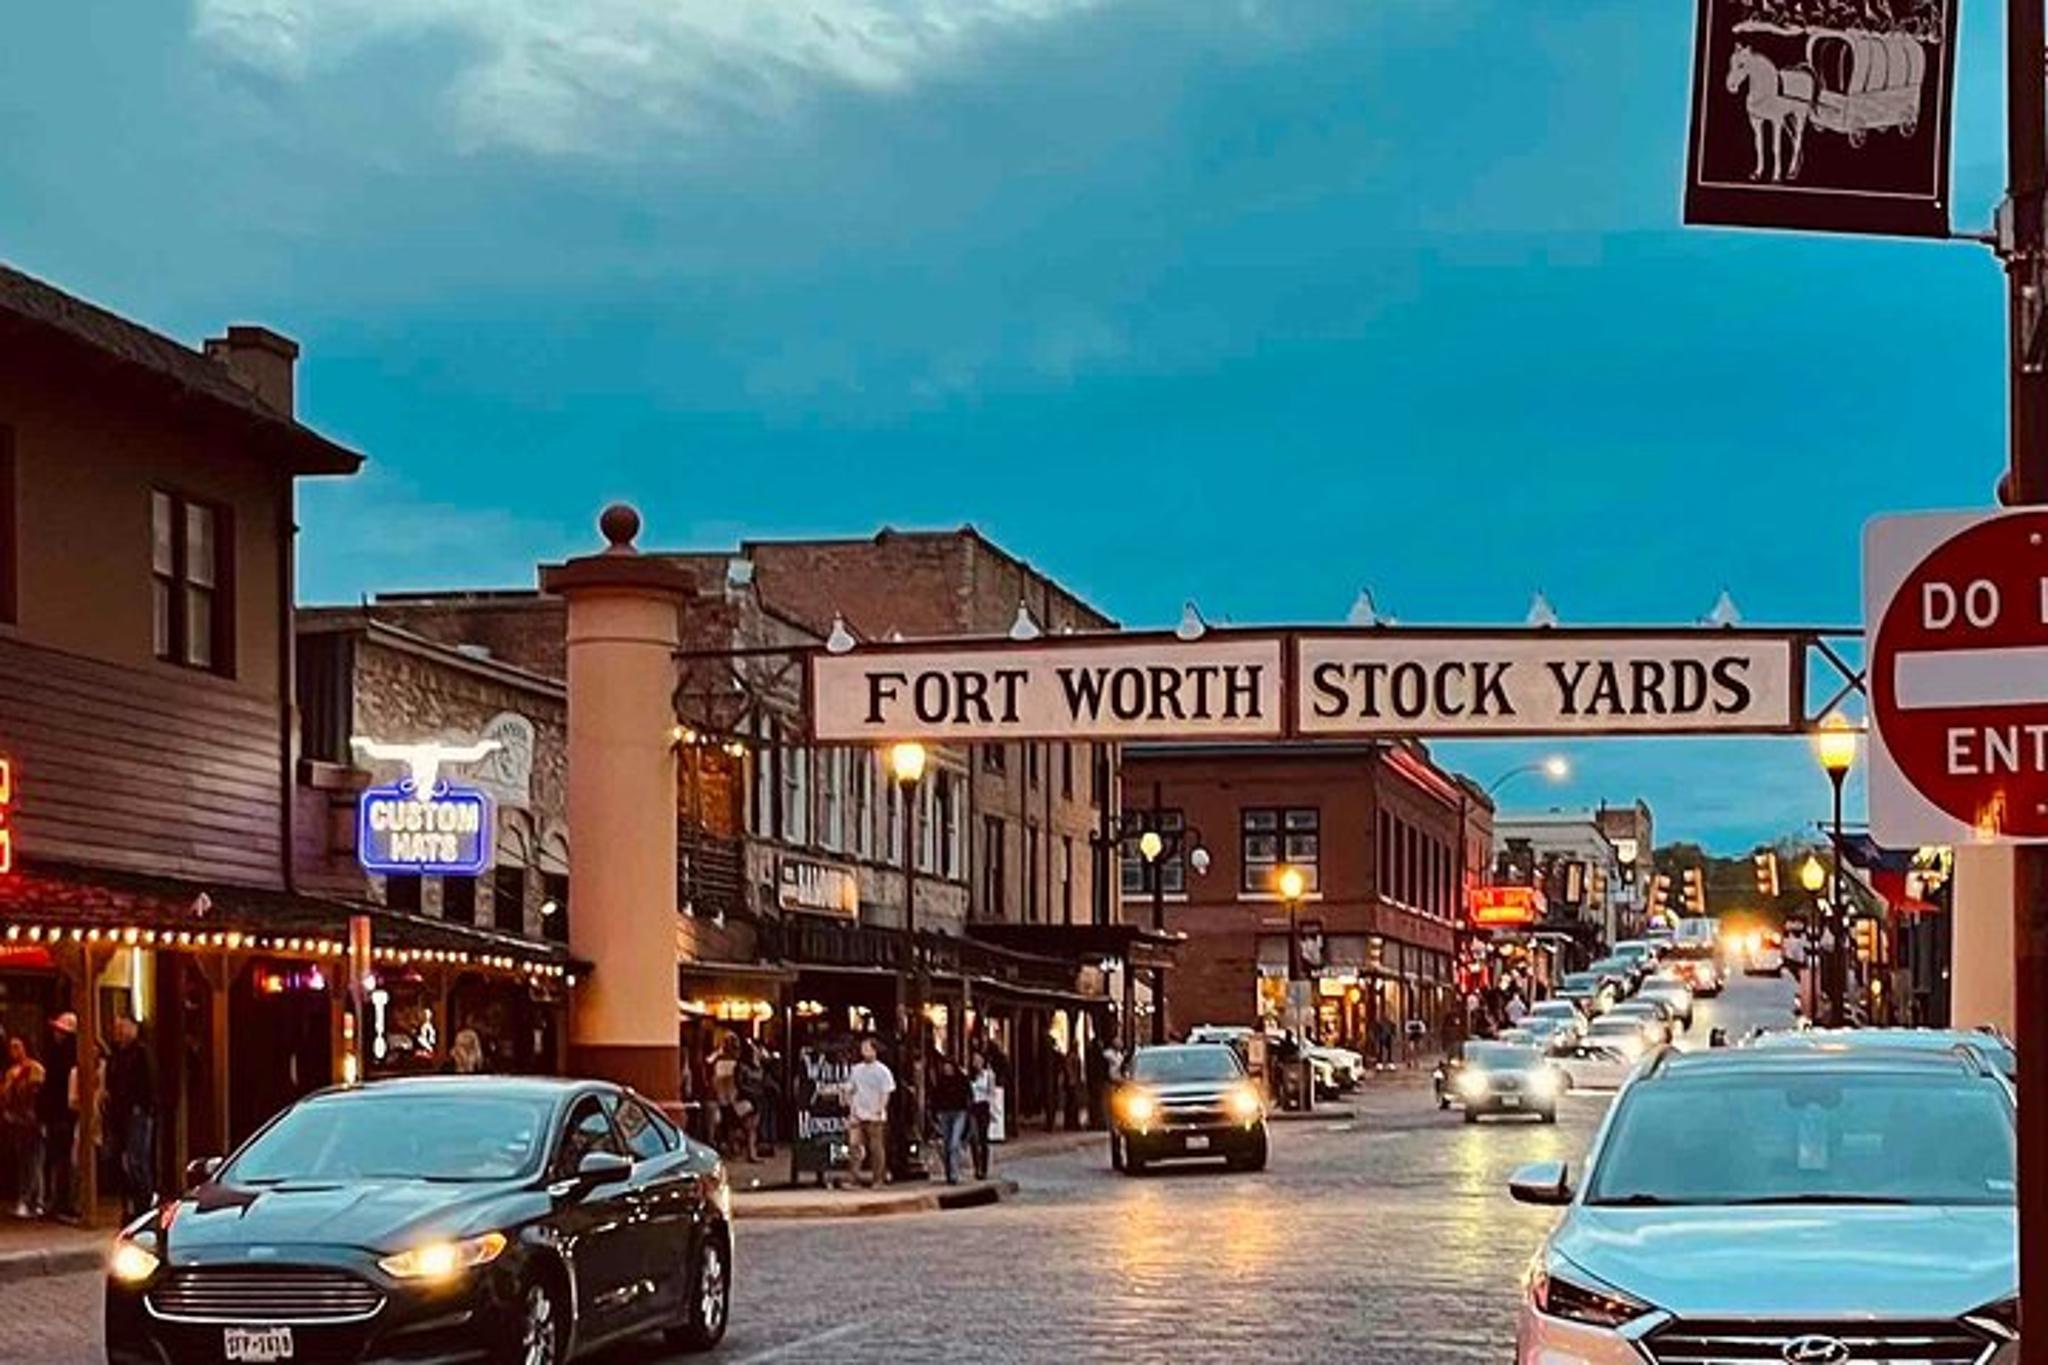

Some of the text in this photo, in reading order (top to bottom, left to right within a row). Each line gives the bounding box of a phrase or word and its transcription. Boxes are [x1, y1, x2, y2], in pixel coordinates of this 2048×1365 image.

[1922, 578, 2000, 630] DO
[864, 656, 1752, 724] FORT WORTH STOCK YARDS
[369, 800, 480, 833] CUSTOM
[389, 832, 459, 863] HATS
